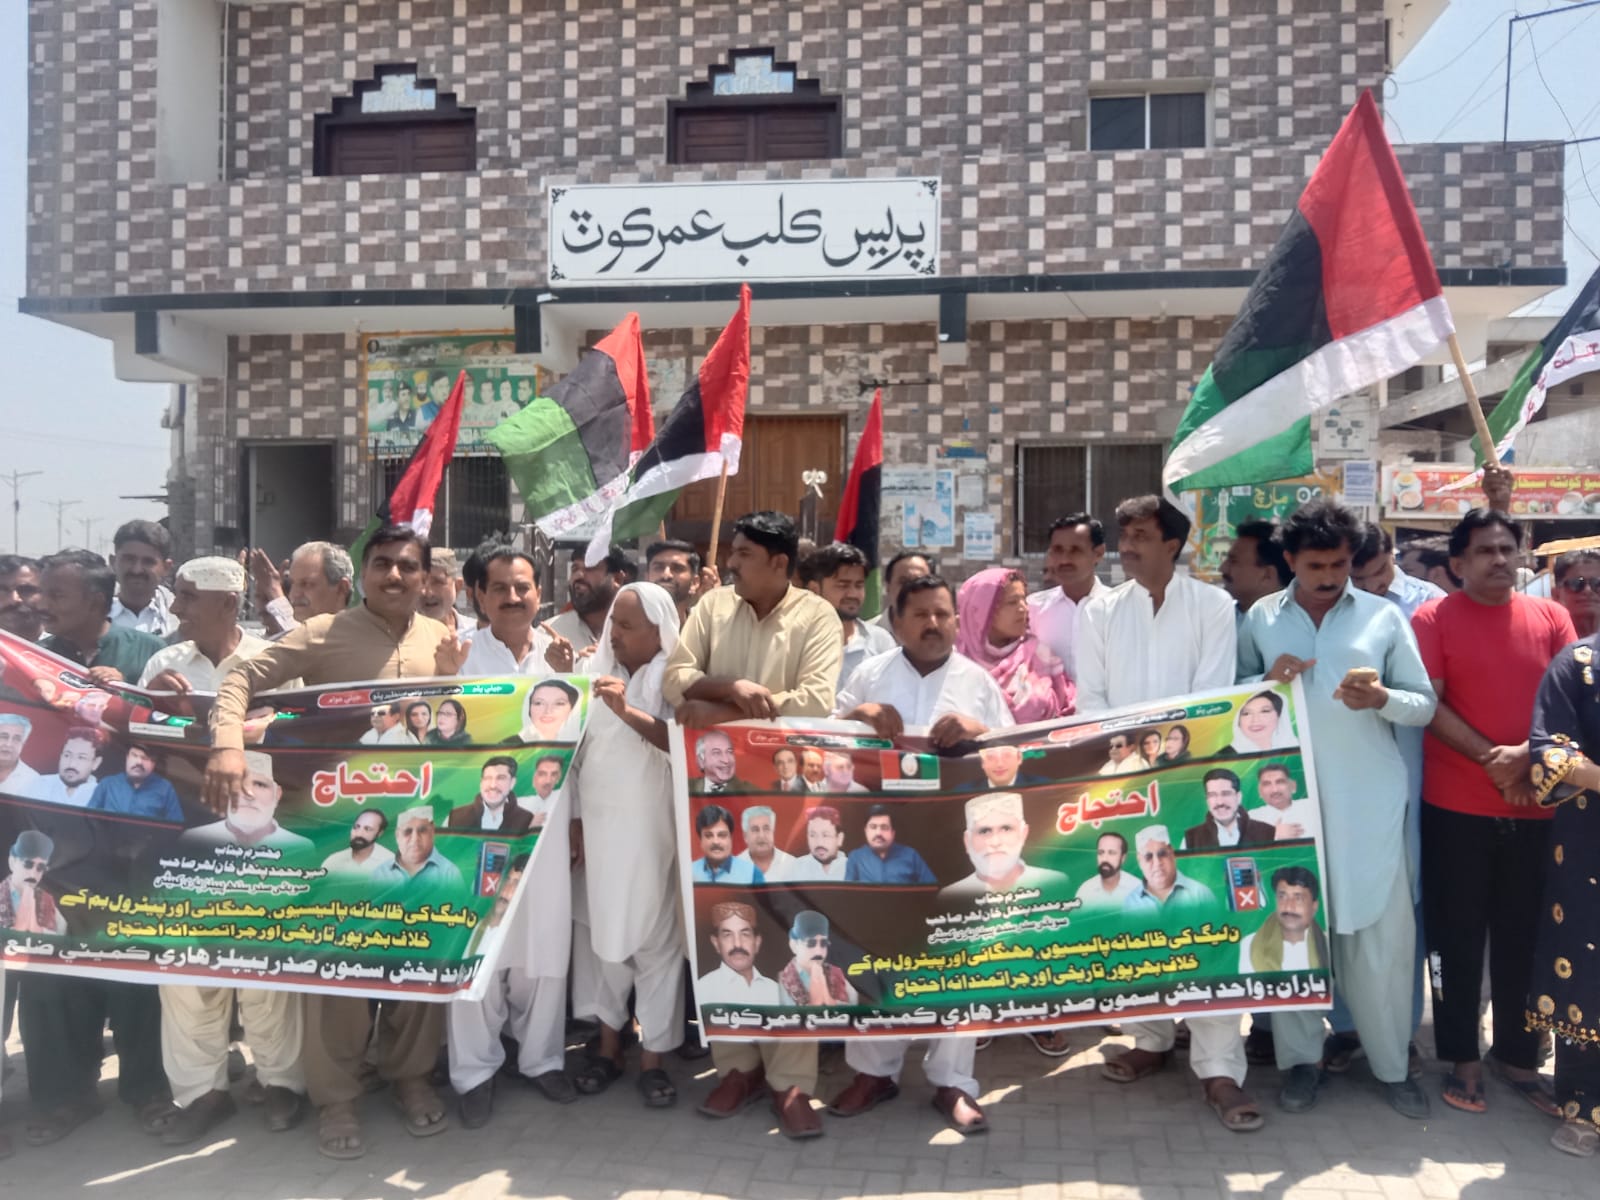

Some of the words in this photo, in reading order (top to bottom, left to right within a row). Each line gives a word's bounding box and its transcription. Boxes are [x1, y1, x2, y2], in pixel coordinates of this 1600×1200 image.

[312, 761, 433, 807] احتجاج
[1056, 780, 1160, 835] احتجاج
[105, 919, 164, 938] احتجاج
[4, 936, 54, 957] ضلع
[894, 975, 946, 998] احتجاج
[805, 1009, 849, 1030] ضلع
